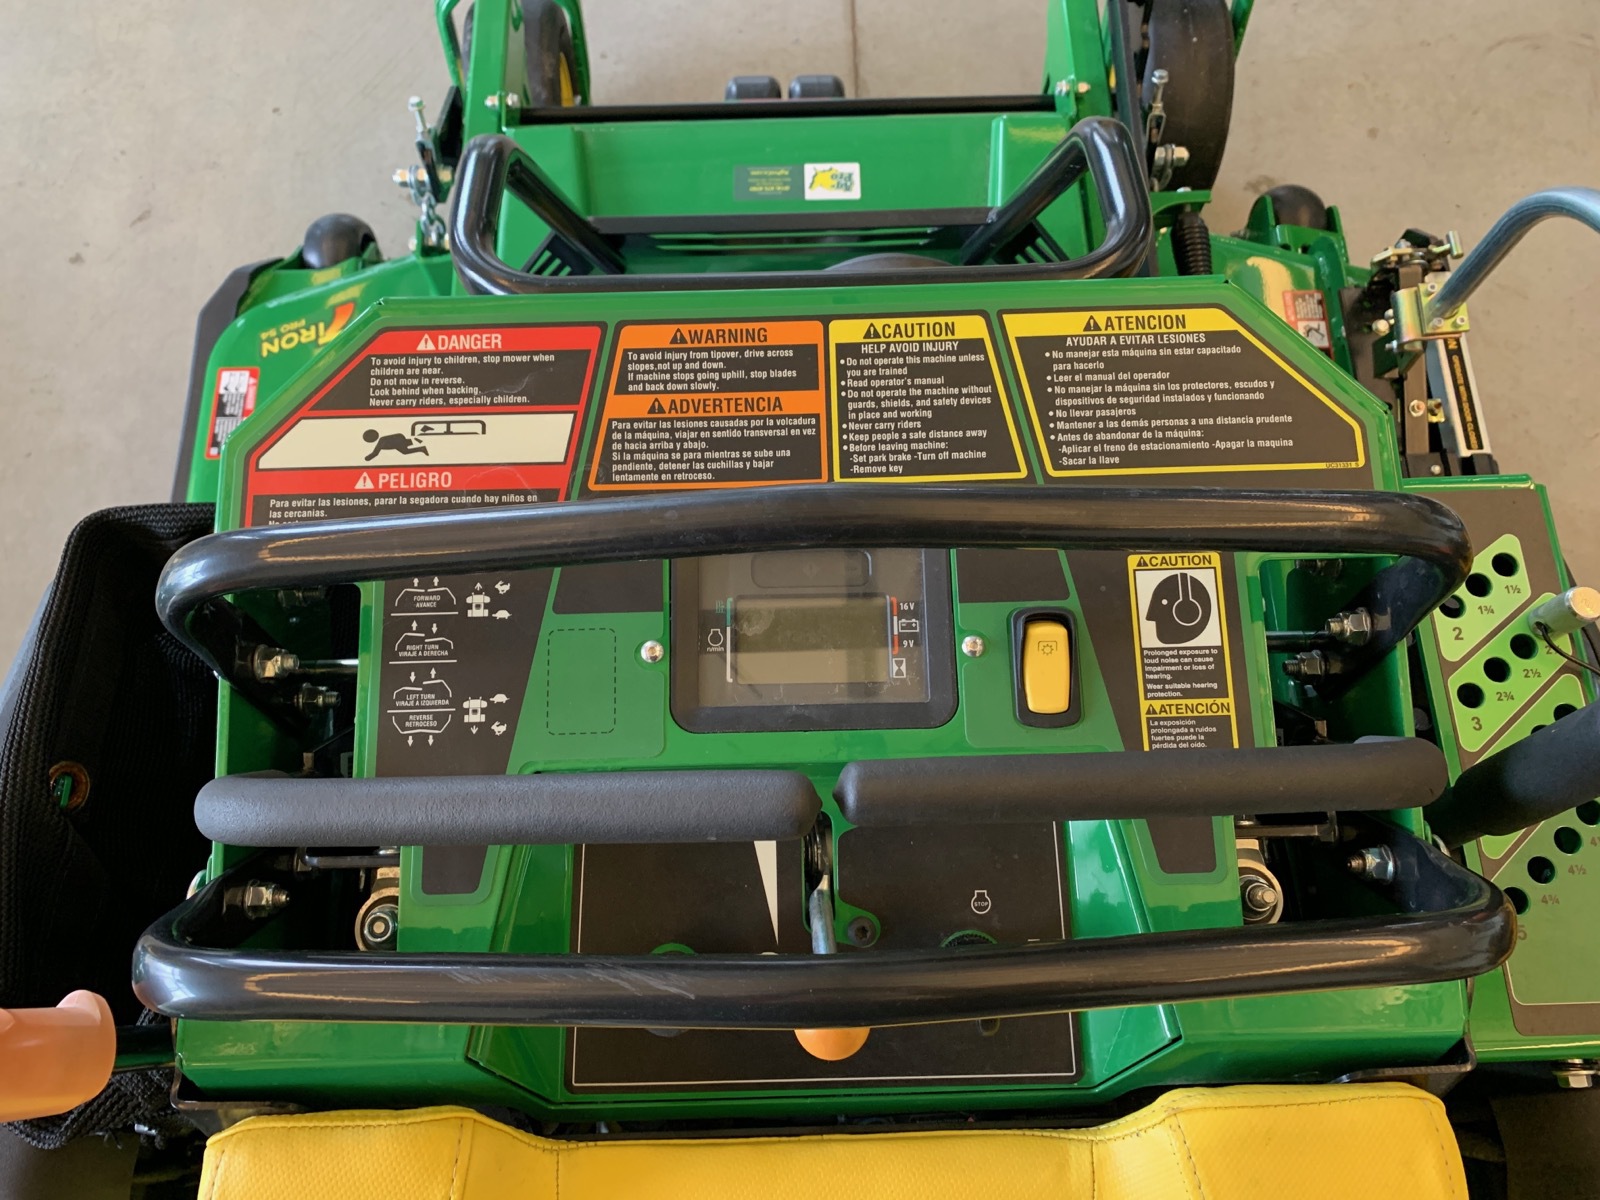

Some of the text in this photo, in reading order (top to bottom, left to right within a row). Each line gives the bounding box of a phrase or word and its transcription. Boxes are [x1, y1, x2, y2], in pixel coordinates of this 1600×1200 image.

[1104, 315, 1186, 331] ATENCION
[688, 328, 768, 344] WARNING
[882, 322, 955, 338] CAUTION
[438, 333, 501, 350] DANGER
[1066, 332, 1205, 346] AYUDAR A EVITAR LESIONES
[861, 341, 958, 353] HELP AVOID INJURY
[1052, 350, 1063, 358] No
[1065, 349, 1099, 359] manejar
[1121, 347, 1156, 357] máquina
[1159, 347, 1171, 355] sin
[1174, 347, 1194, 355] estar
[1196, 345, 1240, 355] capacitado
[371, 357, 380, 365] To
[383, 356, 405, 365] avoid
[408, 356, 431, 366] injury
[433, 356, 441, 364] to
[444, 355, 480, 364] children,
[483, 354, 500, 364] stop
[532, 353, 554, 361] when
[627, 351, 637, 360] To
[639, 351, 661, 360] avoid
[664, 351, 687, 360] injury
[689, 350, 708, 358] from
[710, 350, 741, 359] tipover,
[744, 349, 764, 357] drive
[846, 353, 984, 366] Do not operate this machine unless
[370, 367, 403, 375] children
[672, 362, 682, 371] up
[684, 360, 699, 369] and
[702, 360, 726, 368] down.
[1053, 360, 1104, 371] para hacerlo
[628, 369, 796, 381] If machine stops going uphill, stop blades
[846, 369, 860, 378] you
[878, 366, 907, 375] trained
[370, 377, 381, 385] Do
[383, 377, 396, 385] not
[628, 381, 718, 391] and back down slowly.
[847, 375, 944, 387] Read operator's manual
[369, 385, 480, 396] Look behind when backing.
[369, 394, 529, 406] Never carry riders, especially children.
[668, 397, 783, 414] ADVERTENCIA
[612, 416, 815, 429] Para evitar las lesiones causadas por la volcadura
[378, 471, 451, 488] PELIGRO
[269, 499, 289, 507] Para
[291, 498, 315, 507] evitar
[318, 498, 330, 506] las
[333, 497, 371, 505] lesiones,
[374, 497, 397, 506] parar
[399, 496, 406, 504] la
[409, 495, 448, 505] segadora
[451, 494, 481, 503] cuando
[484, 494, 499, 503] hay
[501, 494, 524, 502] niños
[269, 510, 281, 518] las
[1149, 555, 1212, 567] CAUTION
[900, 602, 914, 610] 16 V
[1452, 627, 1464, 640] 2
[903, 640, 908, 648] 9
[1159, 700, 1230, 715] ATENCIÓN
[1471, 717, 1482, 731] 3
